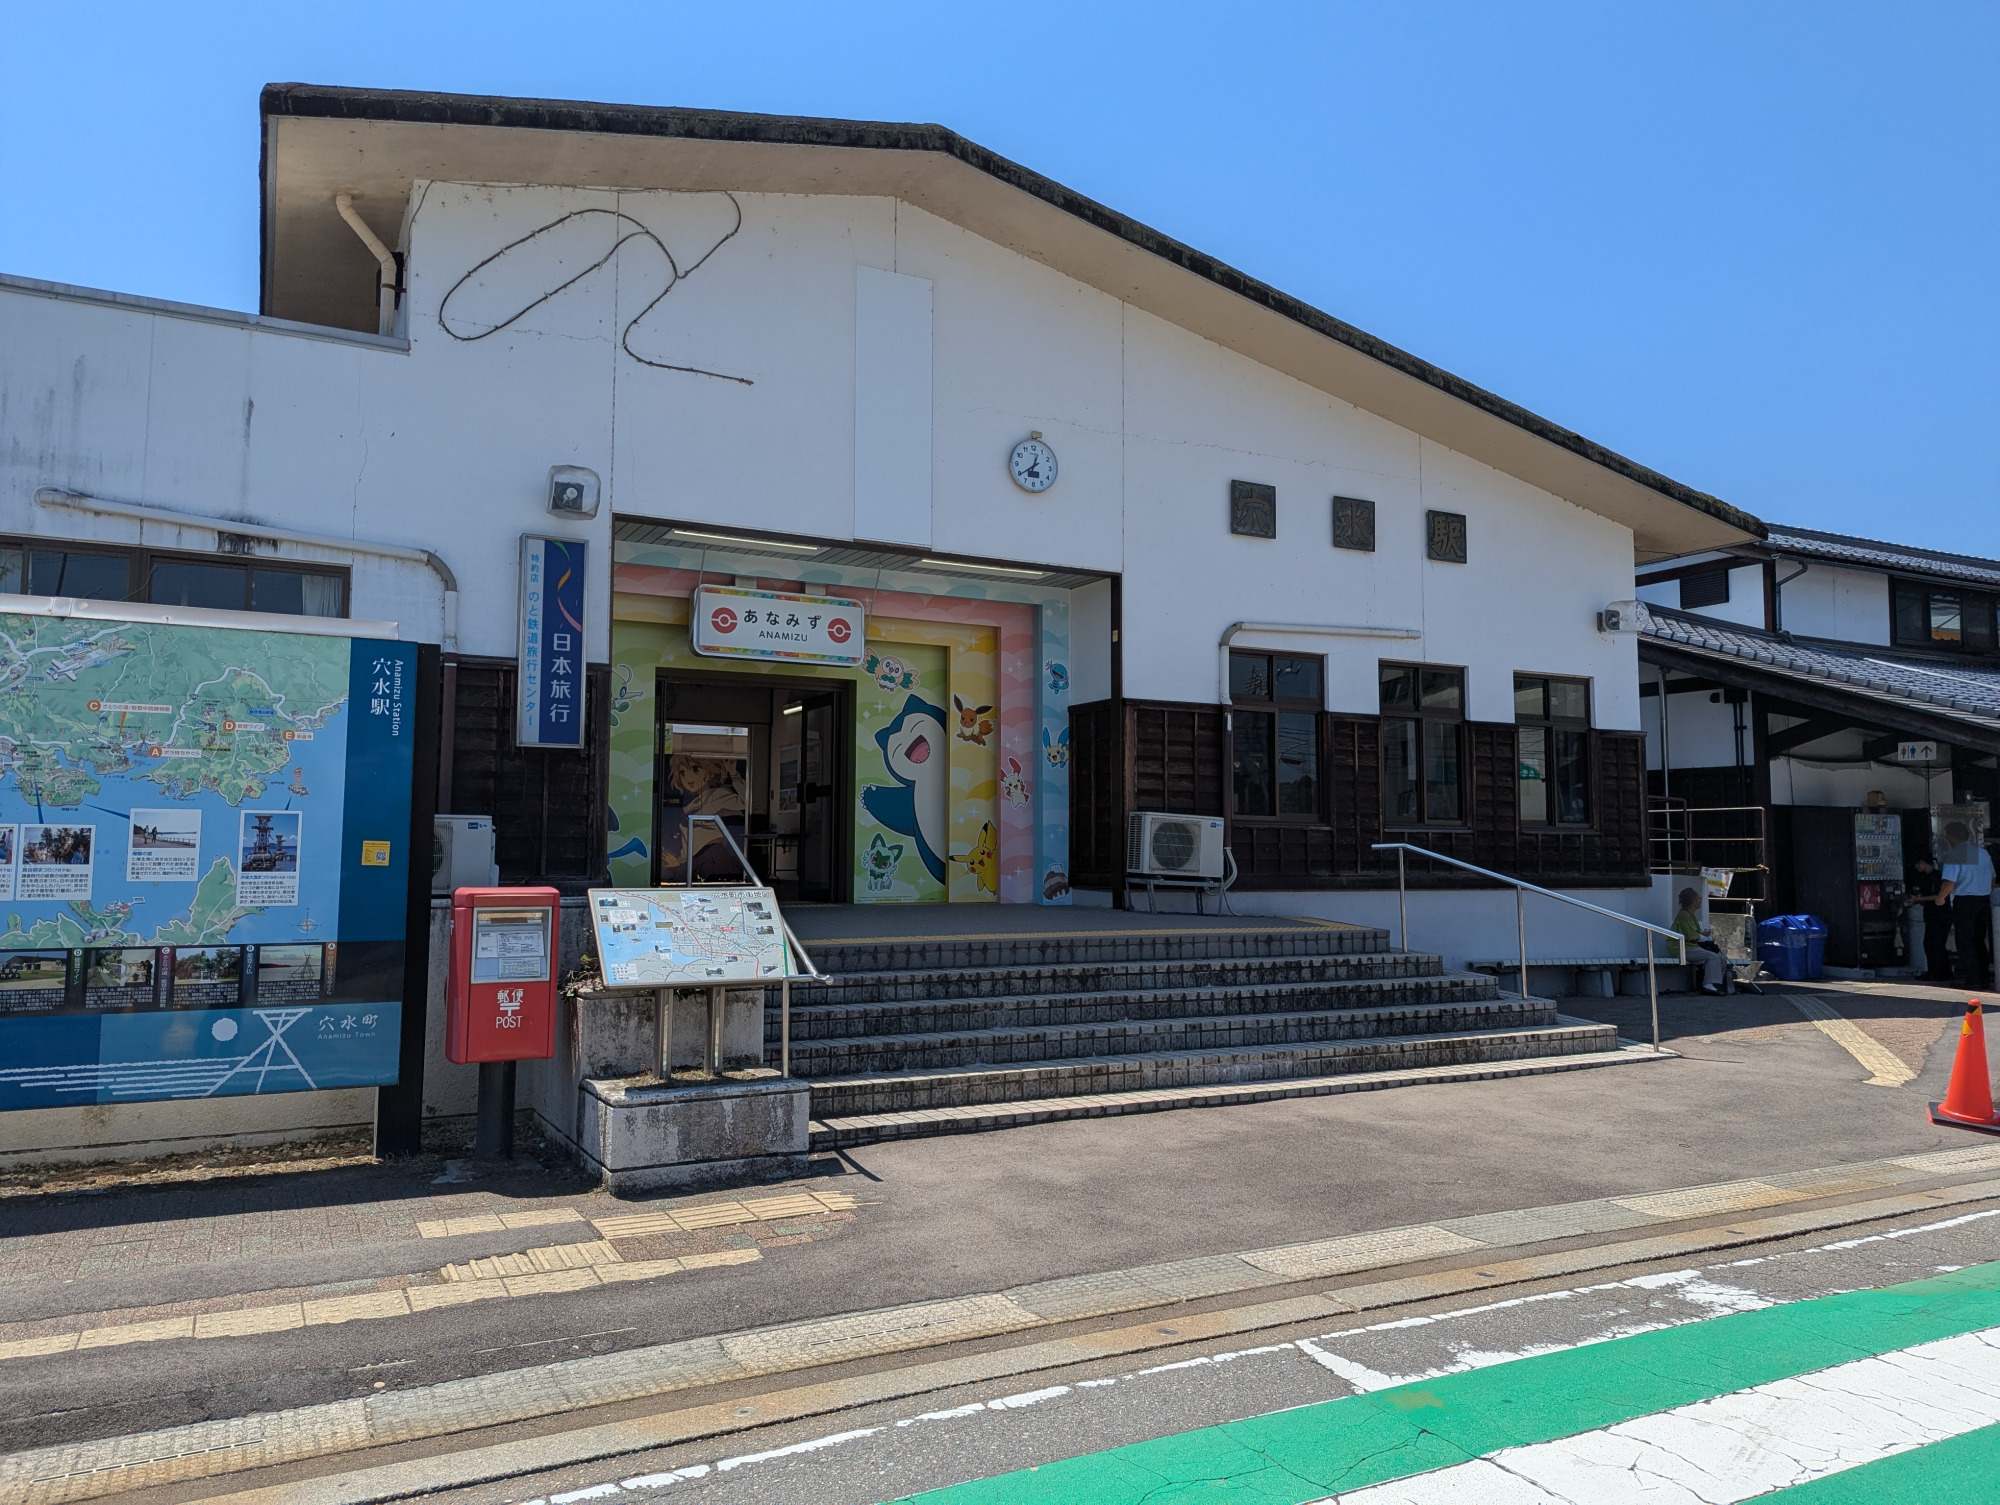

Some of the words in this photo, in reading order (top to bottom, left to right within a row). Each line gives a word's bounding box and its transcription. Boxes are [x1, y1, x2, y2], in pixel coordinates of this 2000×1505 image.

[530, 554, 539, 582] 特約店
[744, 609, 821, 629] あなみず
[759, 631, 808, 642] ANAMIZU
[525, 592, 539, 726] のと鉄道旅行センター
[370, 658, 391, 715] 穴水駅
[394, 660, 403, 700] Anamizu
[550, 633, 572, 723] 日本旅行
[392, 703, 402, 736] Station
[497, 988, 524, 1003] 郵便
[319, 1014, 378, 1031] 穴水町
[496, 1016, 523, 1028] POST
